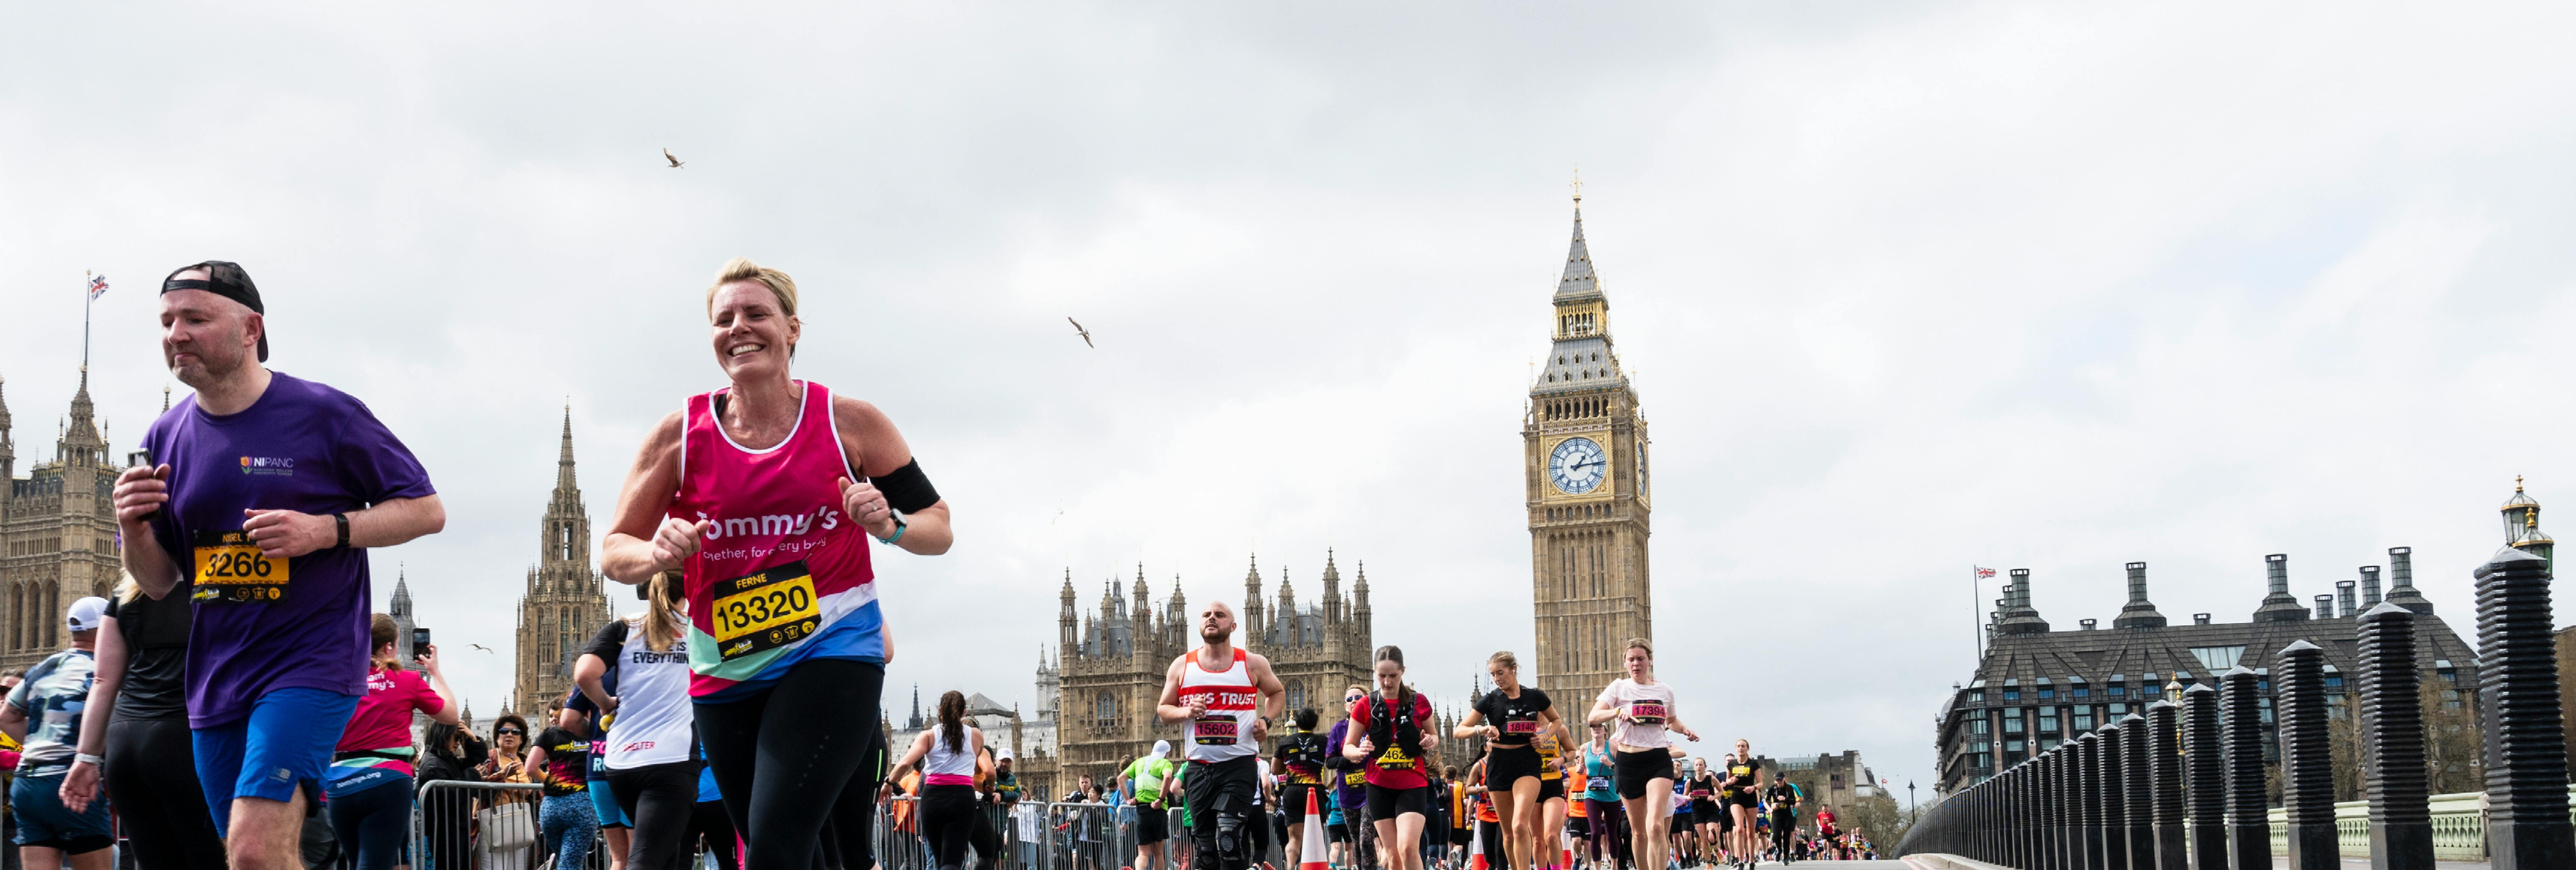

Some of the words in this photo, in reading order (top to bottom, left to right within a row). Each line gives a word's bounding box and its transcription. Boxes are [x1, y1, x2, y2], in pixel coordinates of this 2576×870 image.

[752, 546, 766, 557] for
[205, 552, 272, 577] 3266
[736, 573, 767, 589] FERNE
[717, 585, 809, 632] 13320
[1220, 692, 1256, 705] TRUST
[1635, 706, 1664, 716] 17394
[1198, 724, 1235, 734] 15602
[1510, 723, 1535, 731] 18140
